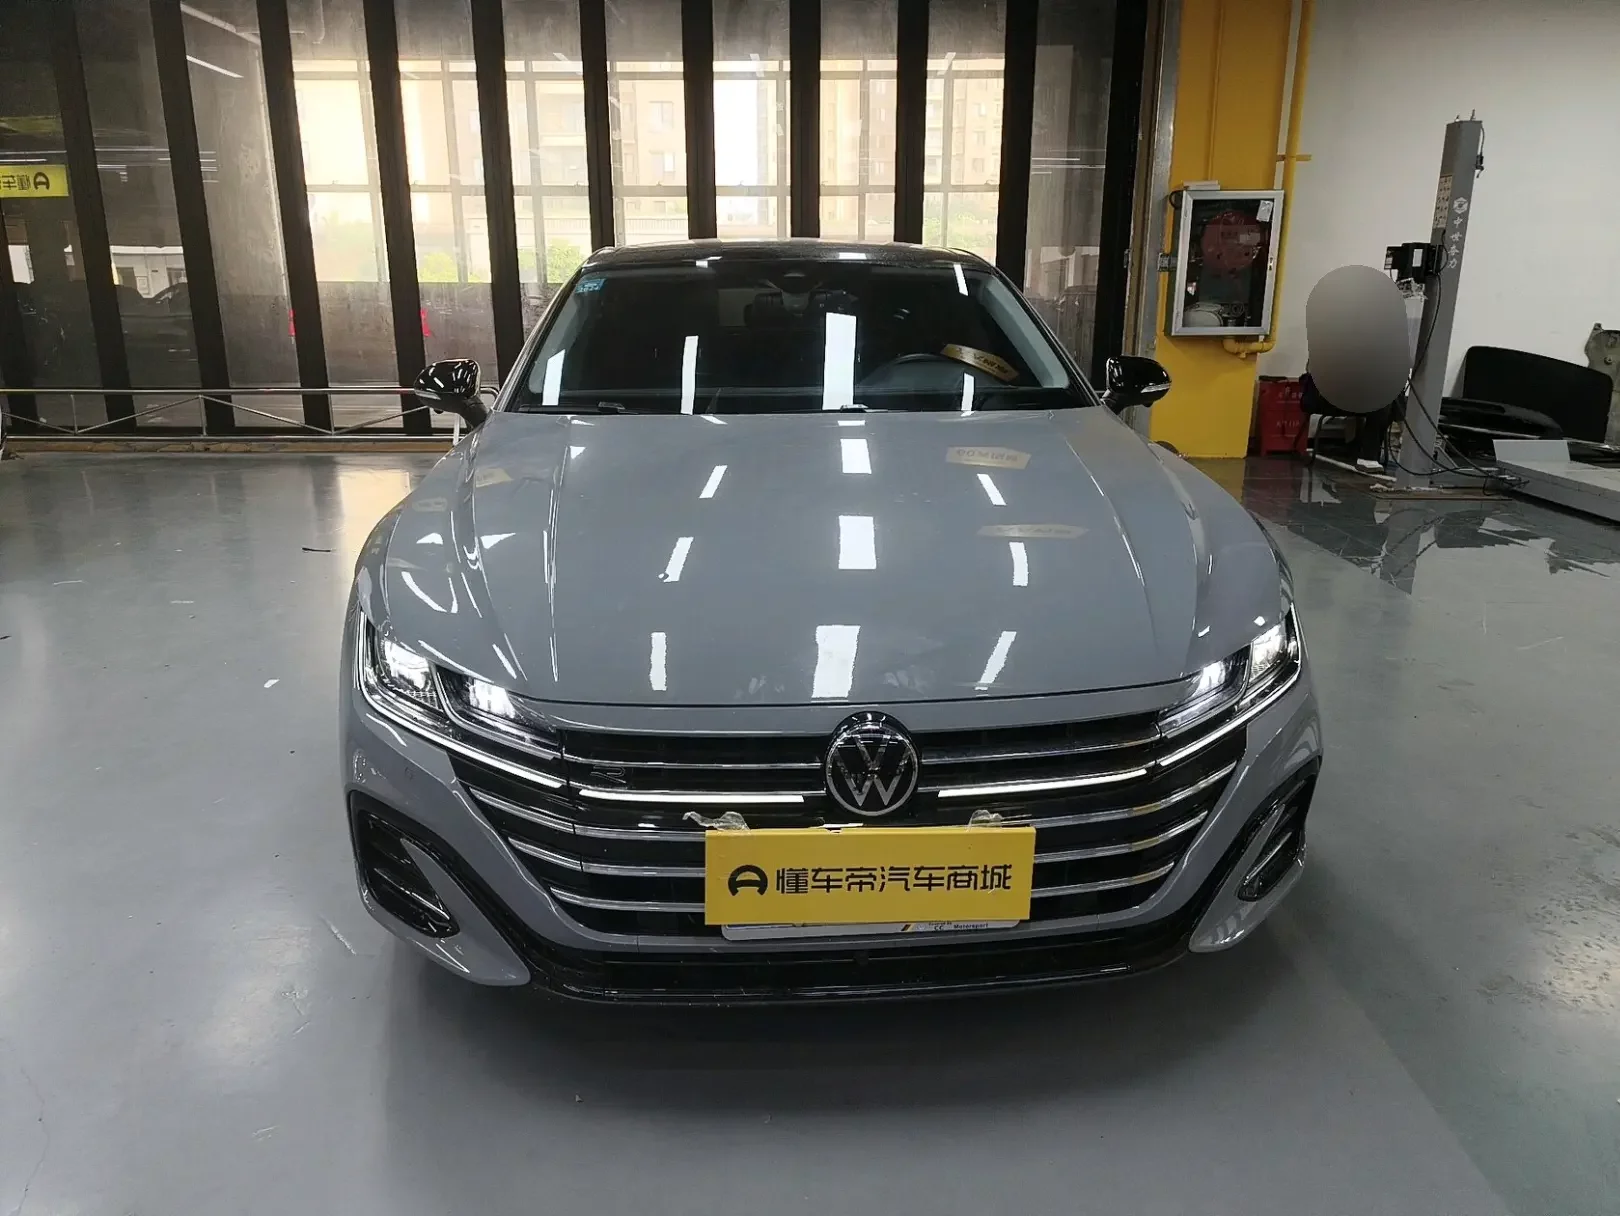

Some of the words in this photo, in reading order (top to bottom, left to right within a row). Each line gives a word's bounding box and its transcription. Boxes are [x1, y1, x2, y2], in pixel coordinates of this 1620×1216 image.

[775, 863, 1013, 895] 懂车帝汽车商城
